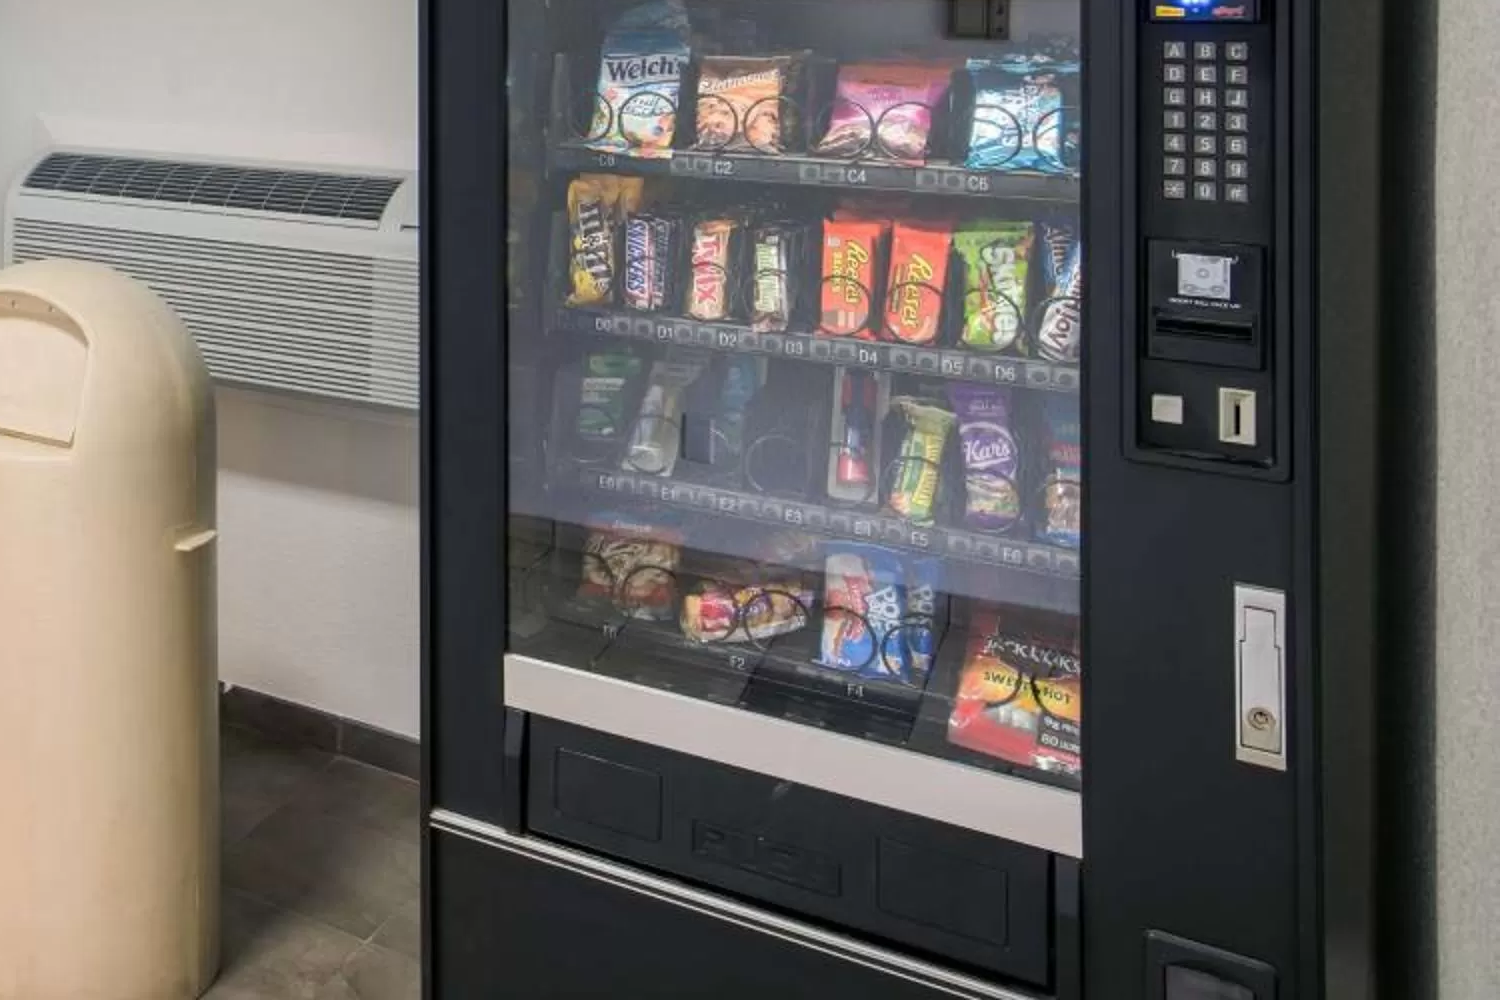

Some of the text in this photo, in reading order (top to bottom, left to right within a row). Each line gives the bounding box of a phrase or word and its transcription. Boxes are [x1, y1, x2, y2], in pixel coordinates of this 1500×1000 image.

[1169, 44, 1242, 58] A B C
[1169, 67, 1241, 82] D E F
[1201, 93, 1211, 105] H
[1231, 93, 1241, 105] J
[1172, 114, 1241, 129] 1 2 3
[1169, 137, 1241, 151] 4 5 6
[714, 162, 734, 176] C2
[1171, 159, 1241, 176] 7 8 9
[847, 169, 866, 184] C4
[657, 325, 673, 339] D1
[719, 332, 737, 347] D2
[859, 349, 877, 364] D4
[942, 358, 962, 374] D5
